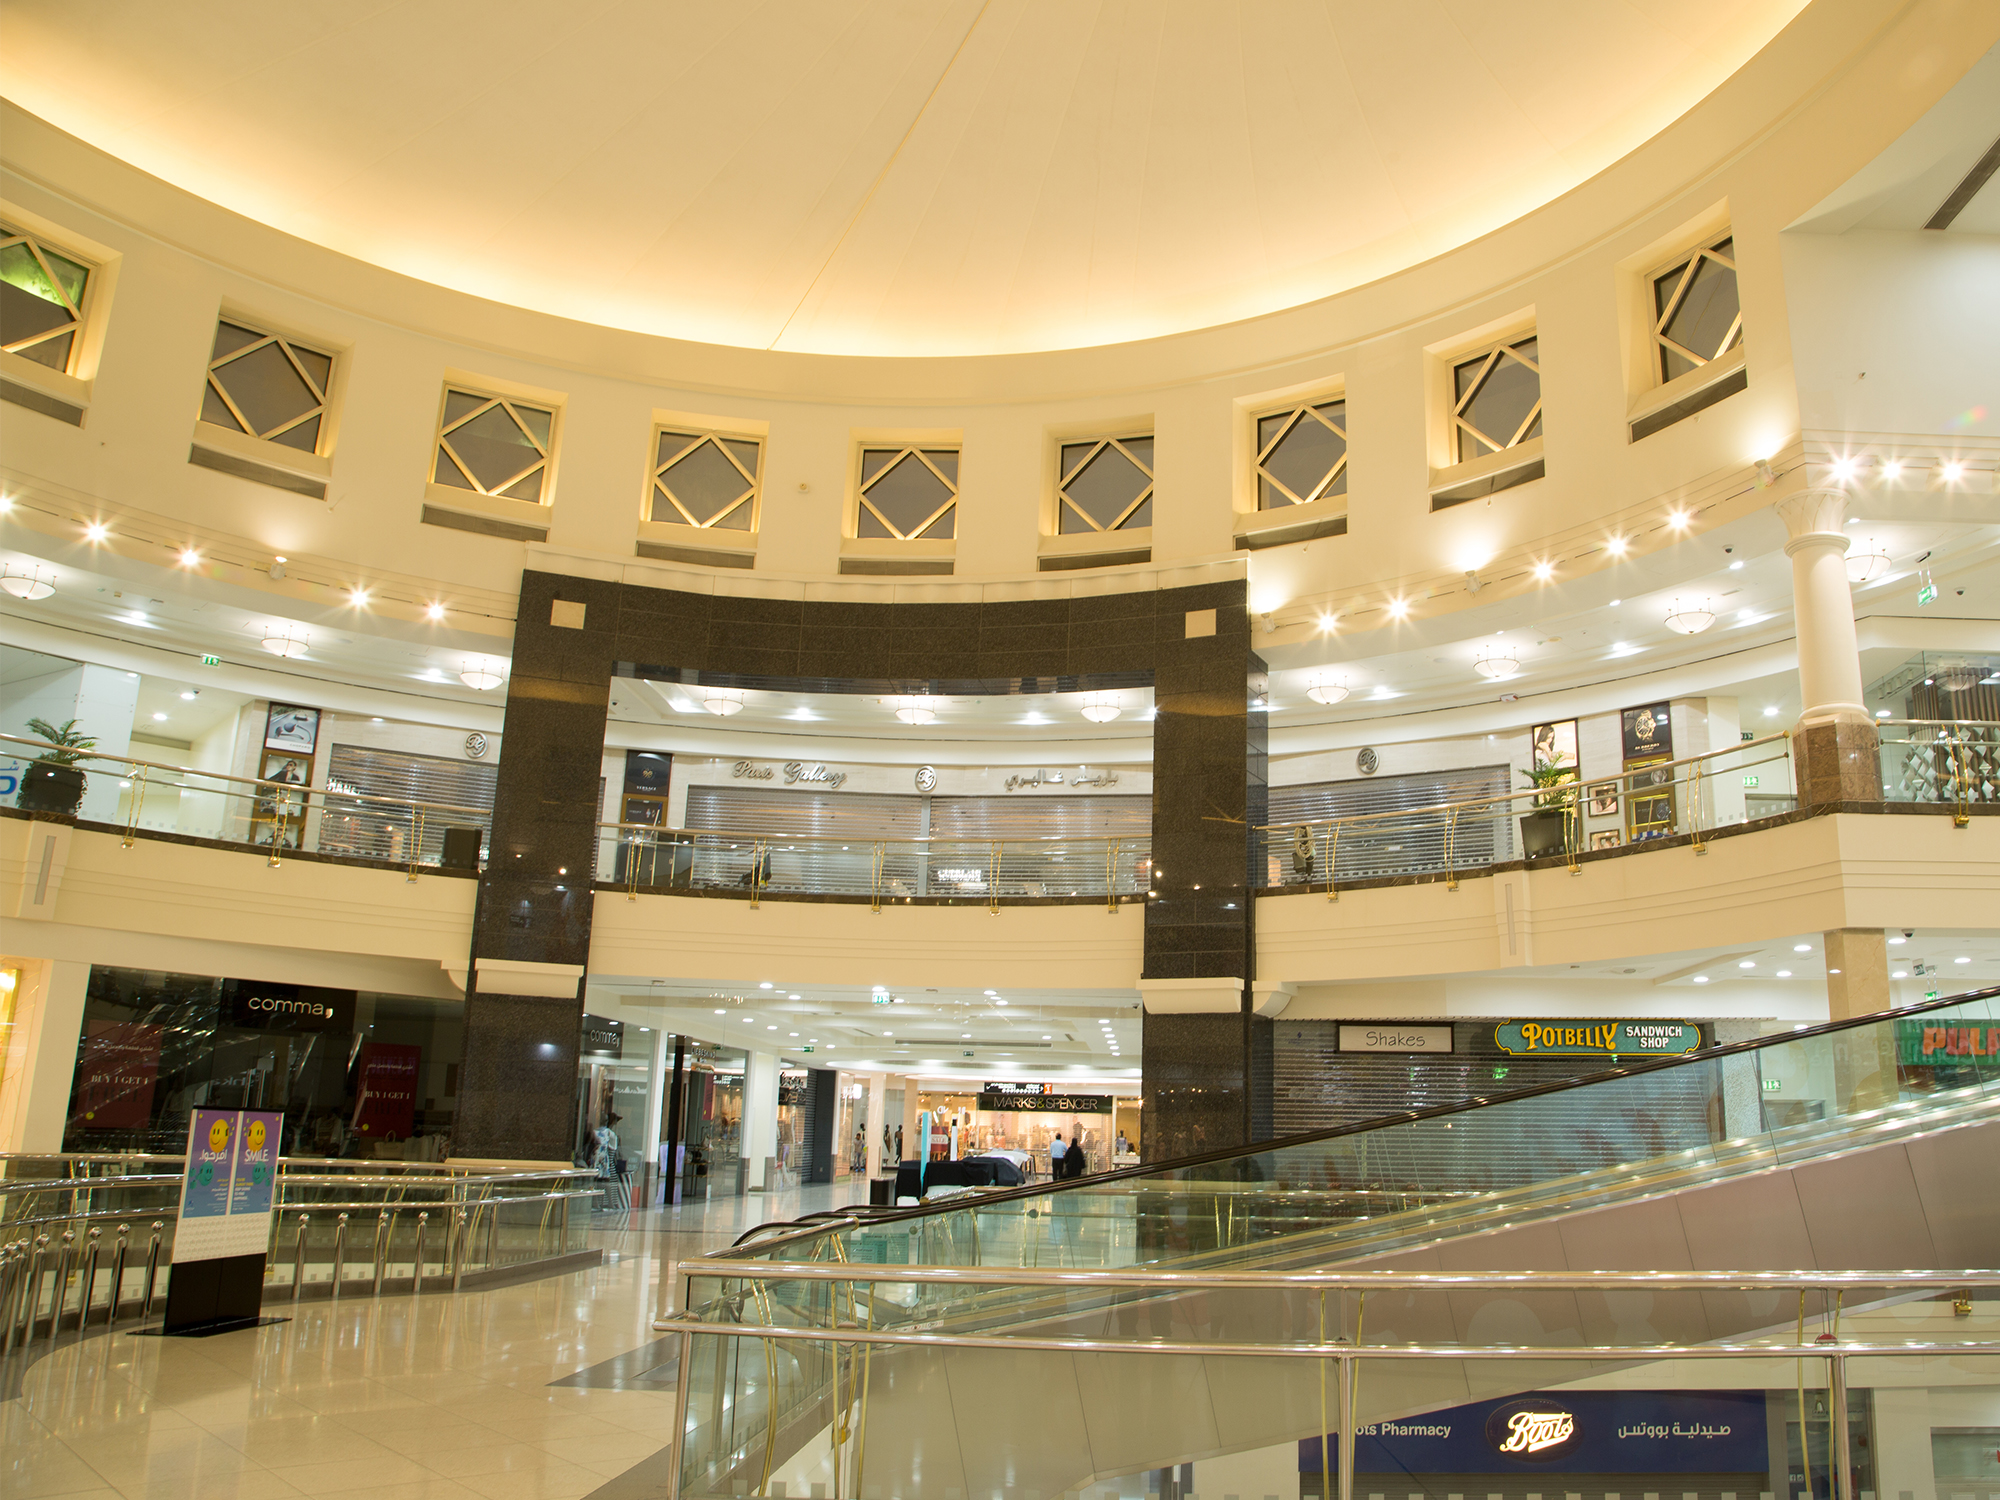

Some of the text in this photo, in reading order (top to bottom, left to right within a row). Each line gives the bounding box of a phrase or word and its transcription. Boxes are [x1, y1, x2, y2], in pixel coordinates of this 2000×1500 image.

[733, 760, 847, 789] Paris Gallery
[1366, 1031, 1426, 1047] Shakes
[1521, 1022, 1620, 1050] POTBELLY
[1626, 1025, 1682, 1037] SANDWICH
[1640, 1037, 1669, 1048] SHOP
[993, 1096, 1036, 1108] MARKS
[1046, 1098, 1098, 1110] SPENCER
[1381, 1423, 1451, 1438] Pharmacy
[1499, 1412, 1574, 1453] Boots
[1672, 1422, 1731, 1439] صيدلية
